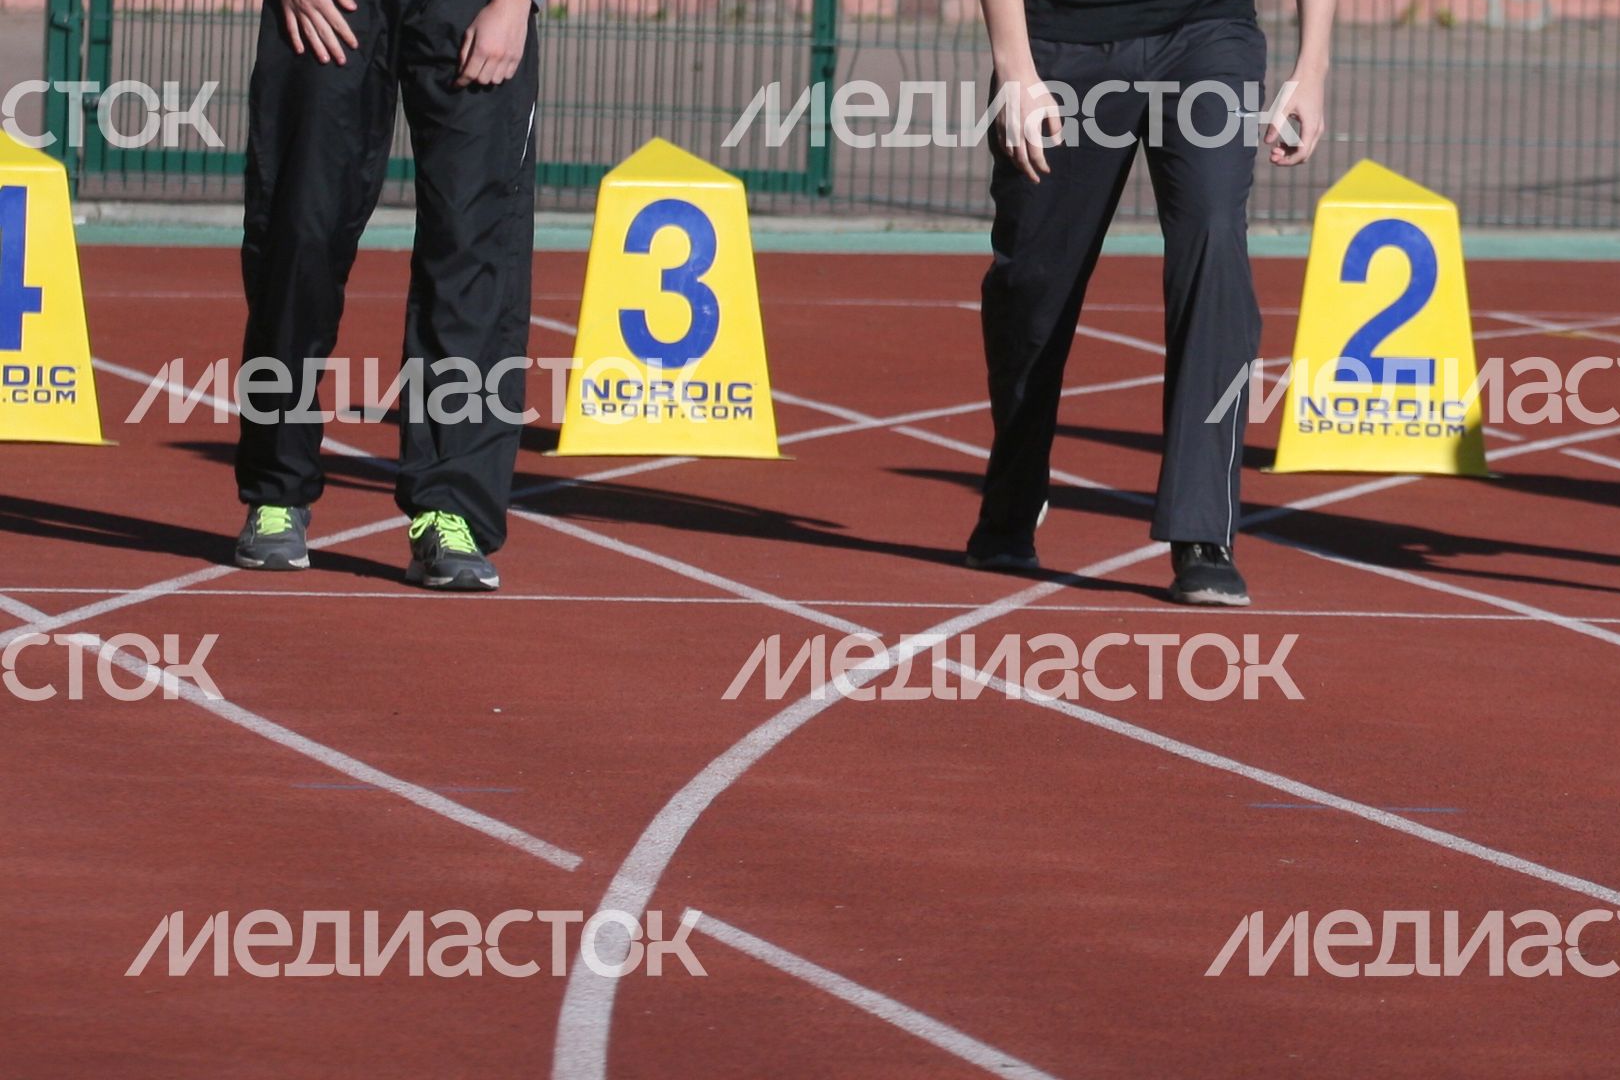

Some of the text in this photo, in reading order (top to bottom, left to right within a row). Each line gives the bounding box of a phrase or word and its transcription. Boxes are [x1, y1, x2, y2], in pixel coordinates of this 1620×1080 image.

[618, 197, 720, 370] 3
[1335, 217, 1437, 390] 2
[581, 379, 753, 403] NORDIC
[580, 402, 753, 420] SPORT.COM
[1299, 396, 1468, 422] NORDIC
[1298, 419, 1467, 438] SPORT.COM
